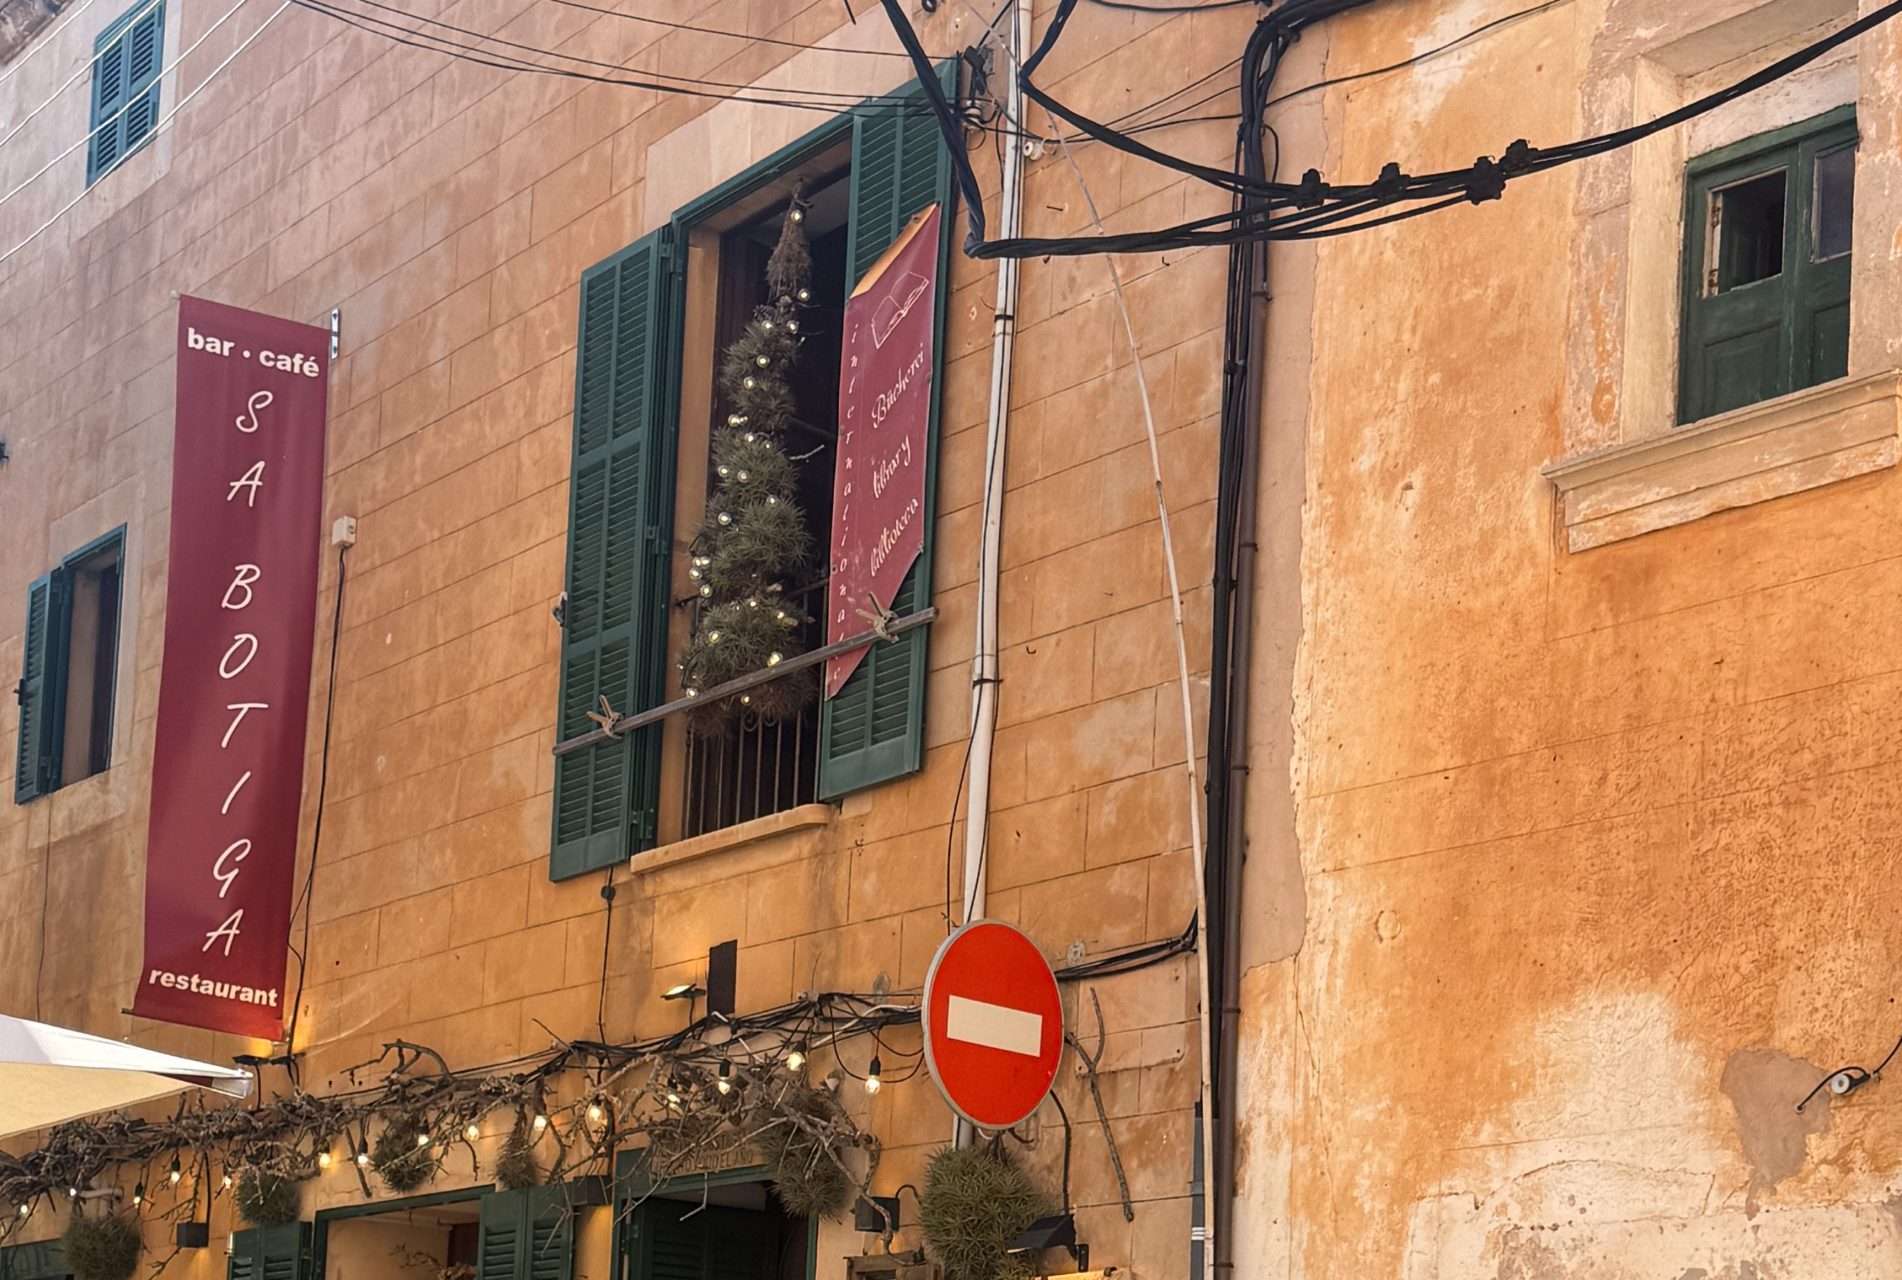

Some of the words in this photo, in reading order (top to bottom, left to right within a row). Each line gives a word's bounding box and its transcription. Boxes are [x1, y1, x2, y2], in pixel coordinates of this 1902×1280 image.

[187, 327, 236, 357] bar
[258, 350, 320, 378] café
[226, 390, 273, 508] SA
[872, 434, 912, 499] library
[201, 563, 269, 957] BOTIGA
[148, 969, 279, 1008] restaurant
